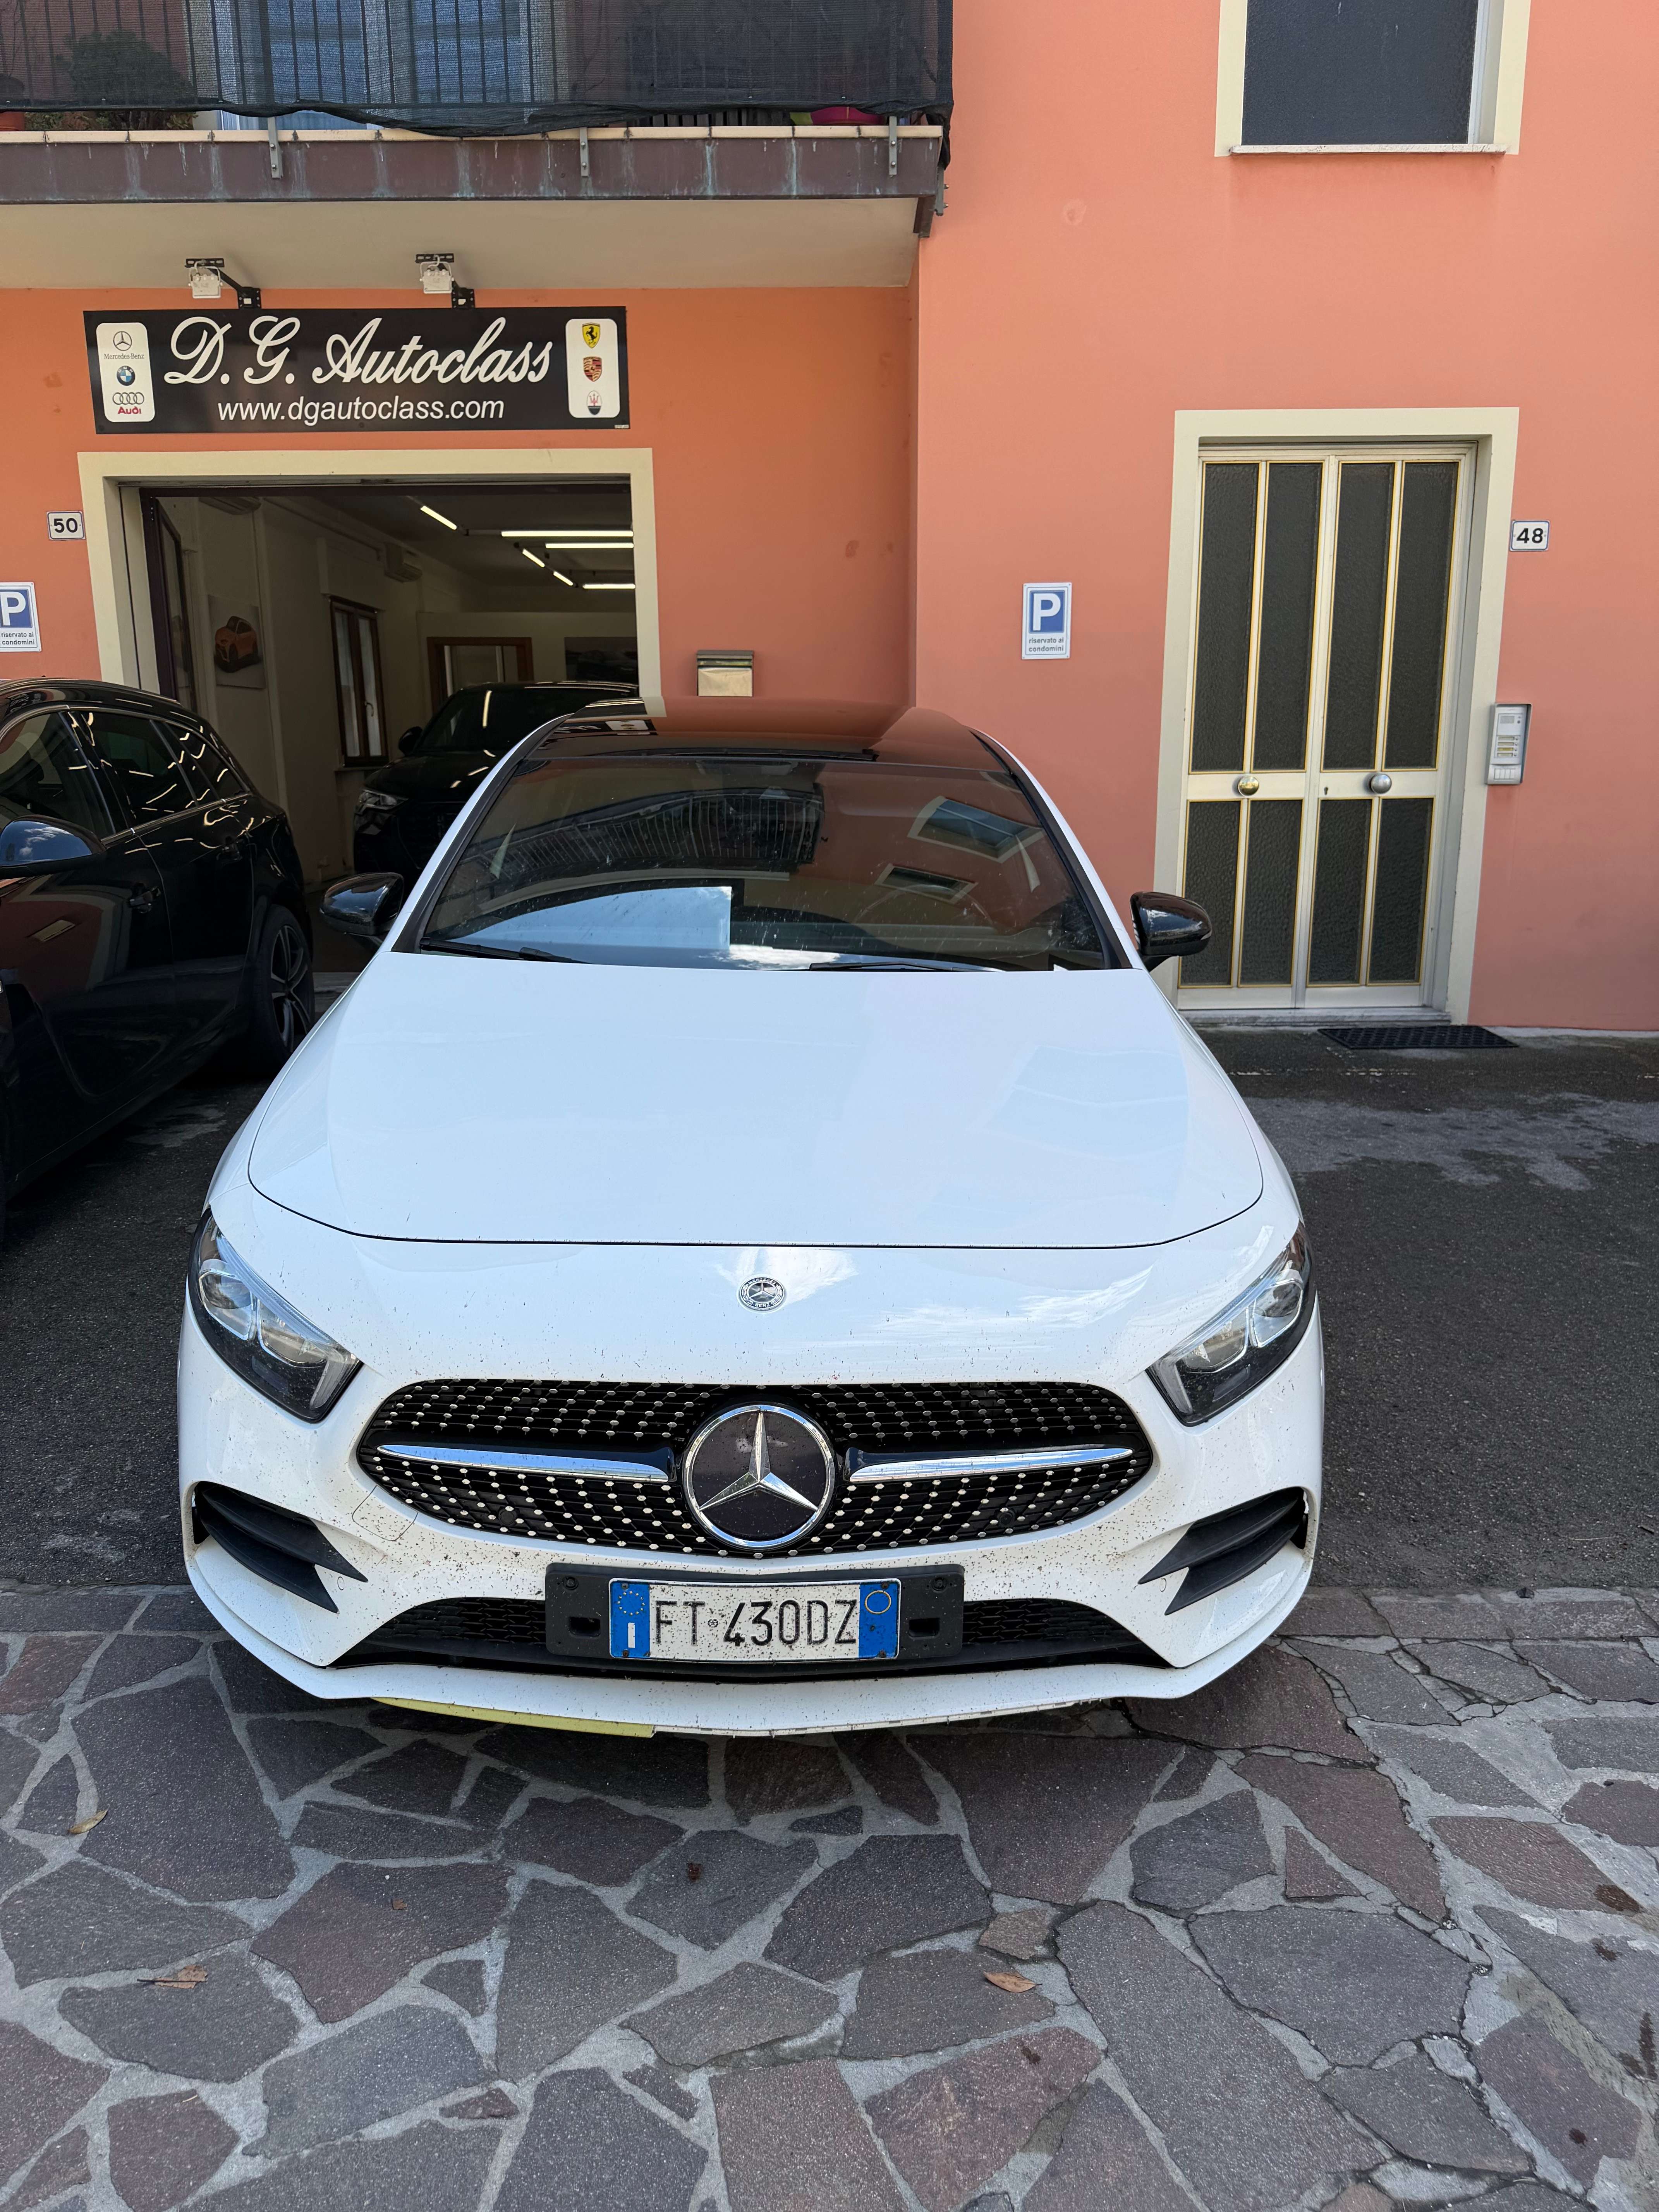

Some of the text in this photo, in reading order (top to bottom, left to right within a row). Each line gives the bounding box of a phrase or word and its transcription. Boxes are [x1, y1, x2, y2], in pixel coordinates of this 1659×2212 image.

[163, 316, 553, 384] D. G. Autoclass
[117, 406, 141, 414] Audi
[218, 395, 504, 426] www.dgautoclass.com
[54, 518, 78, 533] 50
[1516, 528, 1544, 544] 48
[0, 591, 26, 626] P
[1033, 593, 1061, 631] P
[655, 1600, 706, 1645] FT
[723, 1599, 858, 1647] 430DZ
